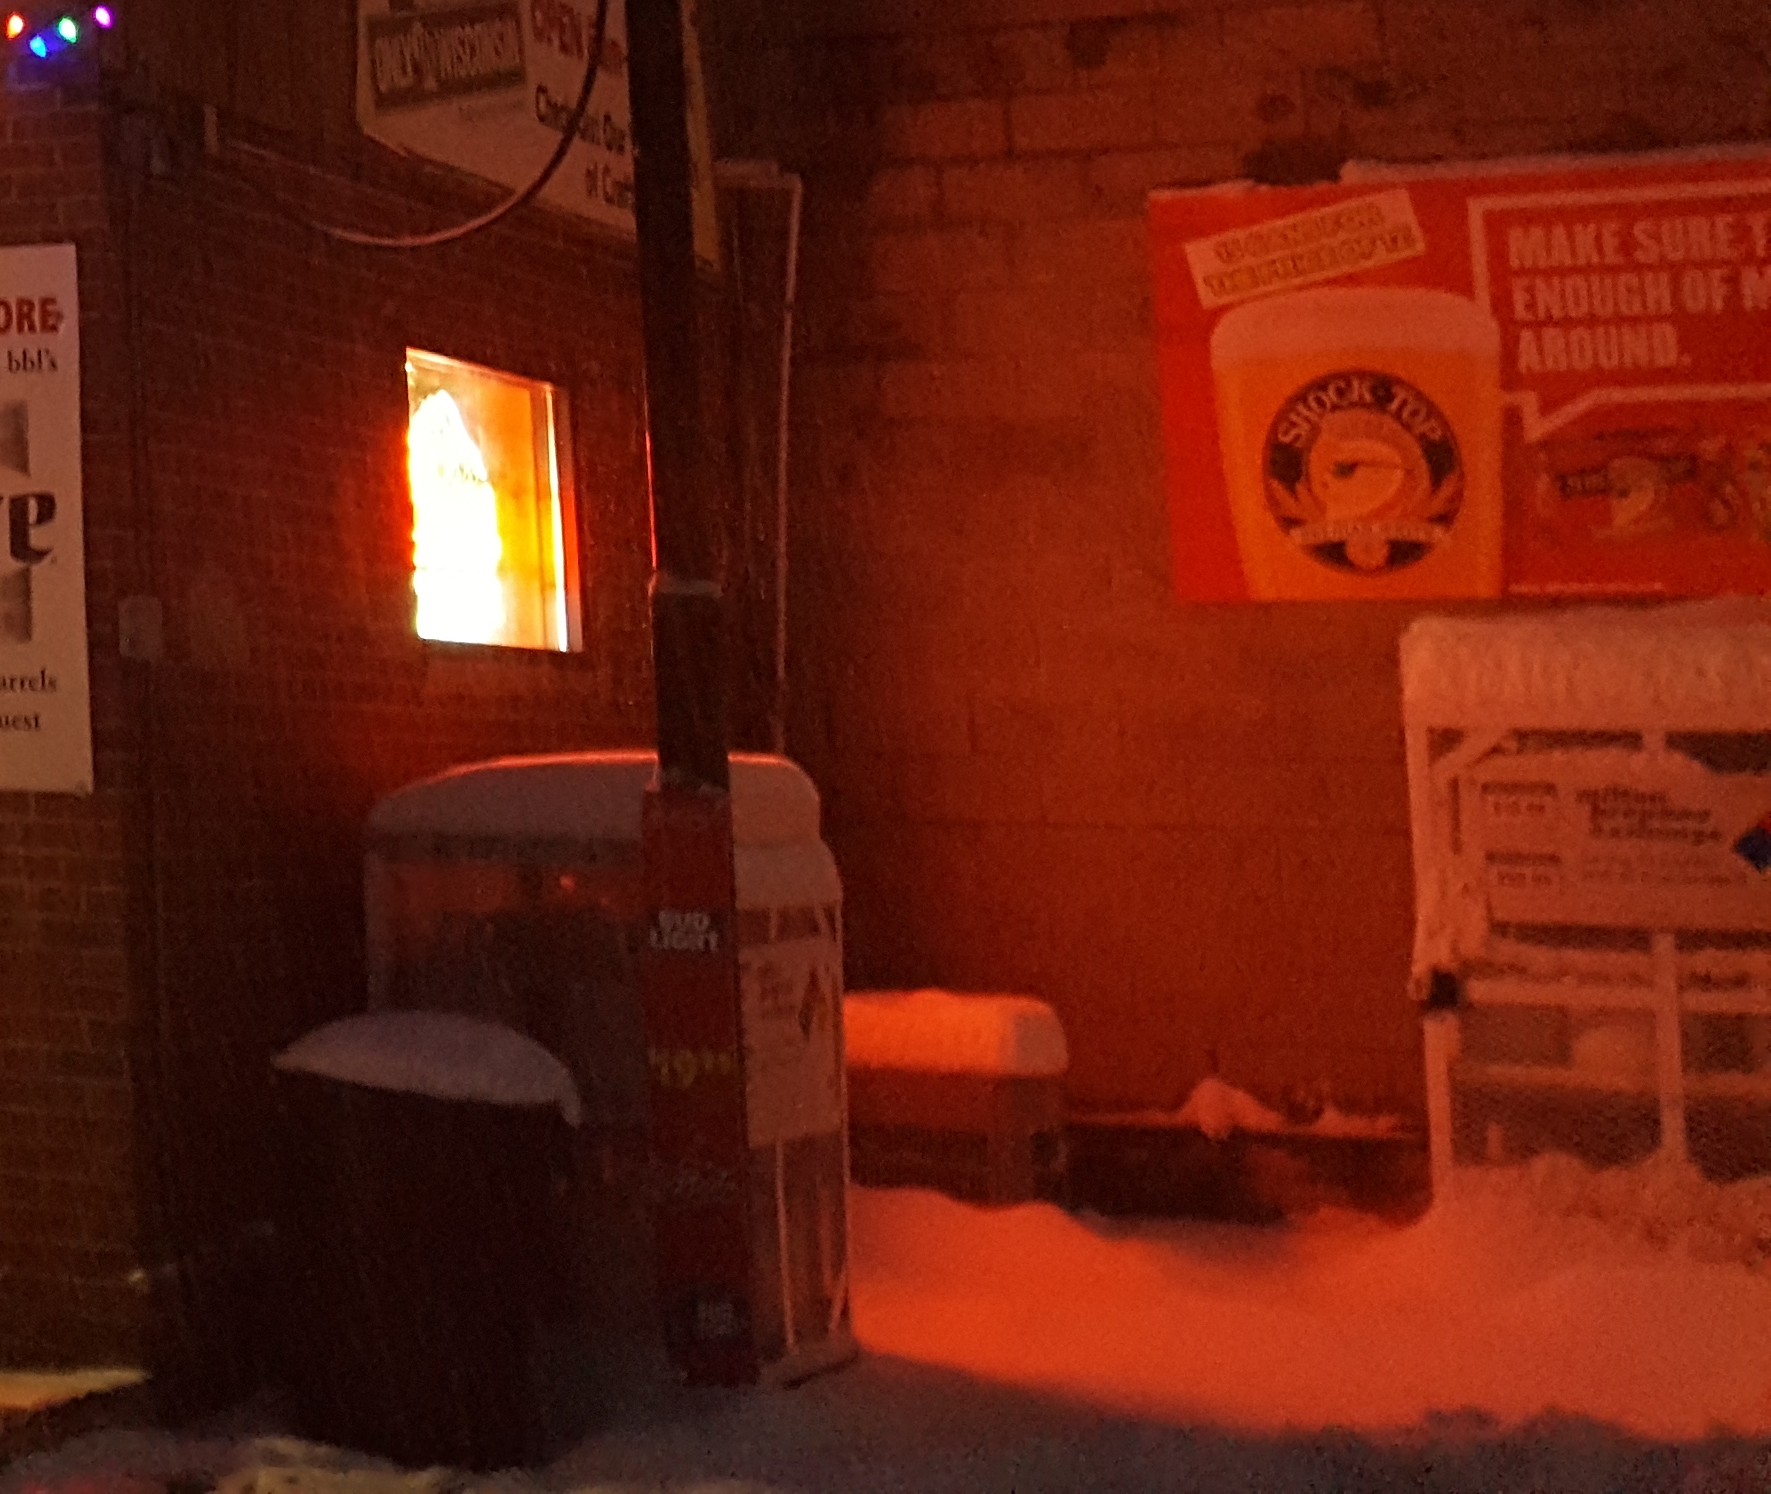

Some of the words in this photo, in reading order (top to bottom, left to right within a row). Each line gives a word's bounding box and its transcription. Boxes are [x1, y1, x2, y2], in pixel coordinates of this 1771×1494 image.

[1509, 222, 1624, 268] MAKE
[1632, 215, 1736, 264] SURE
[1512, 270, 1672, 322] ENOUGH
[1682, 269, 1729, 314] OF
[1279, 376, 1374, 448] SHOCK
[1386, 386, 1442, 441] TOP
[648, 926, 720, 952] LIGHT
